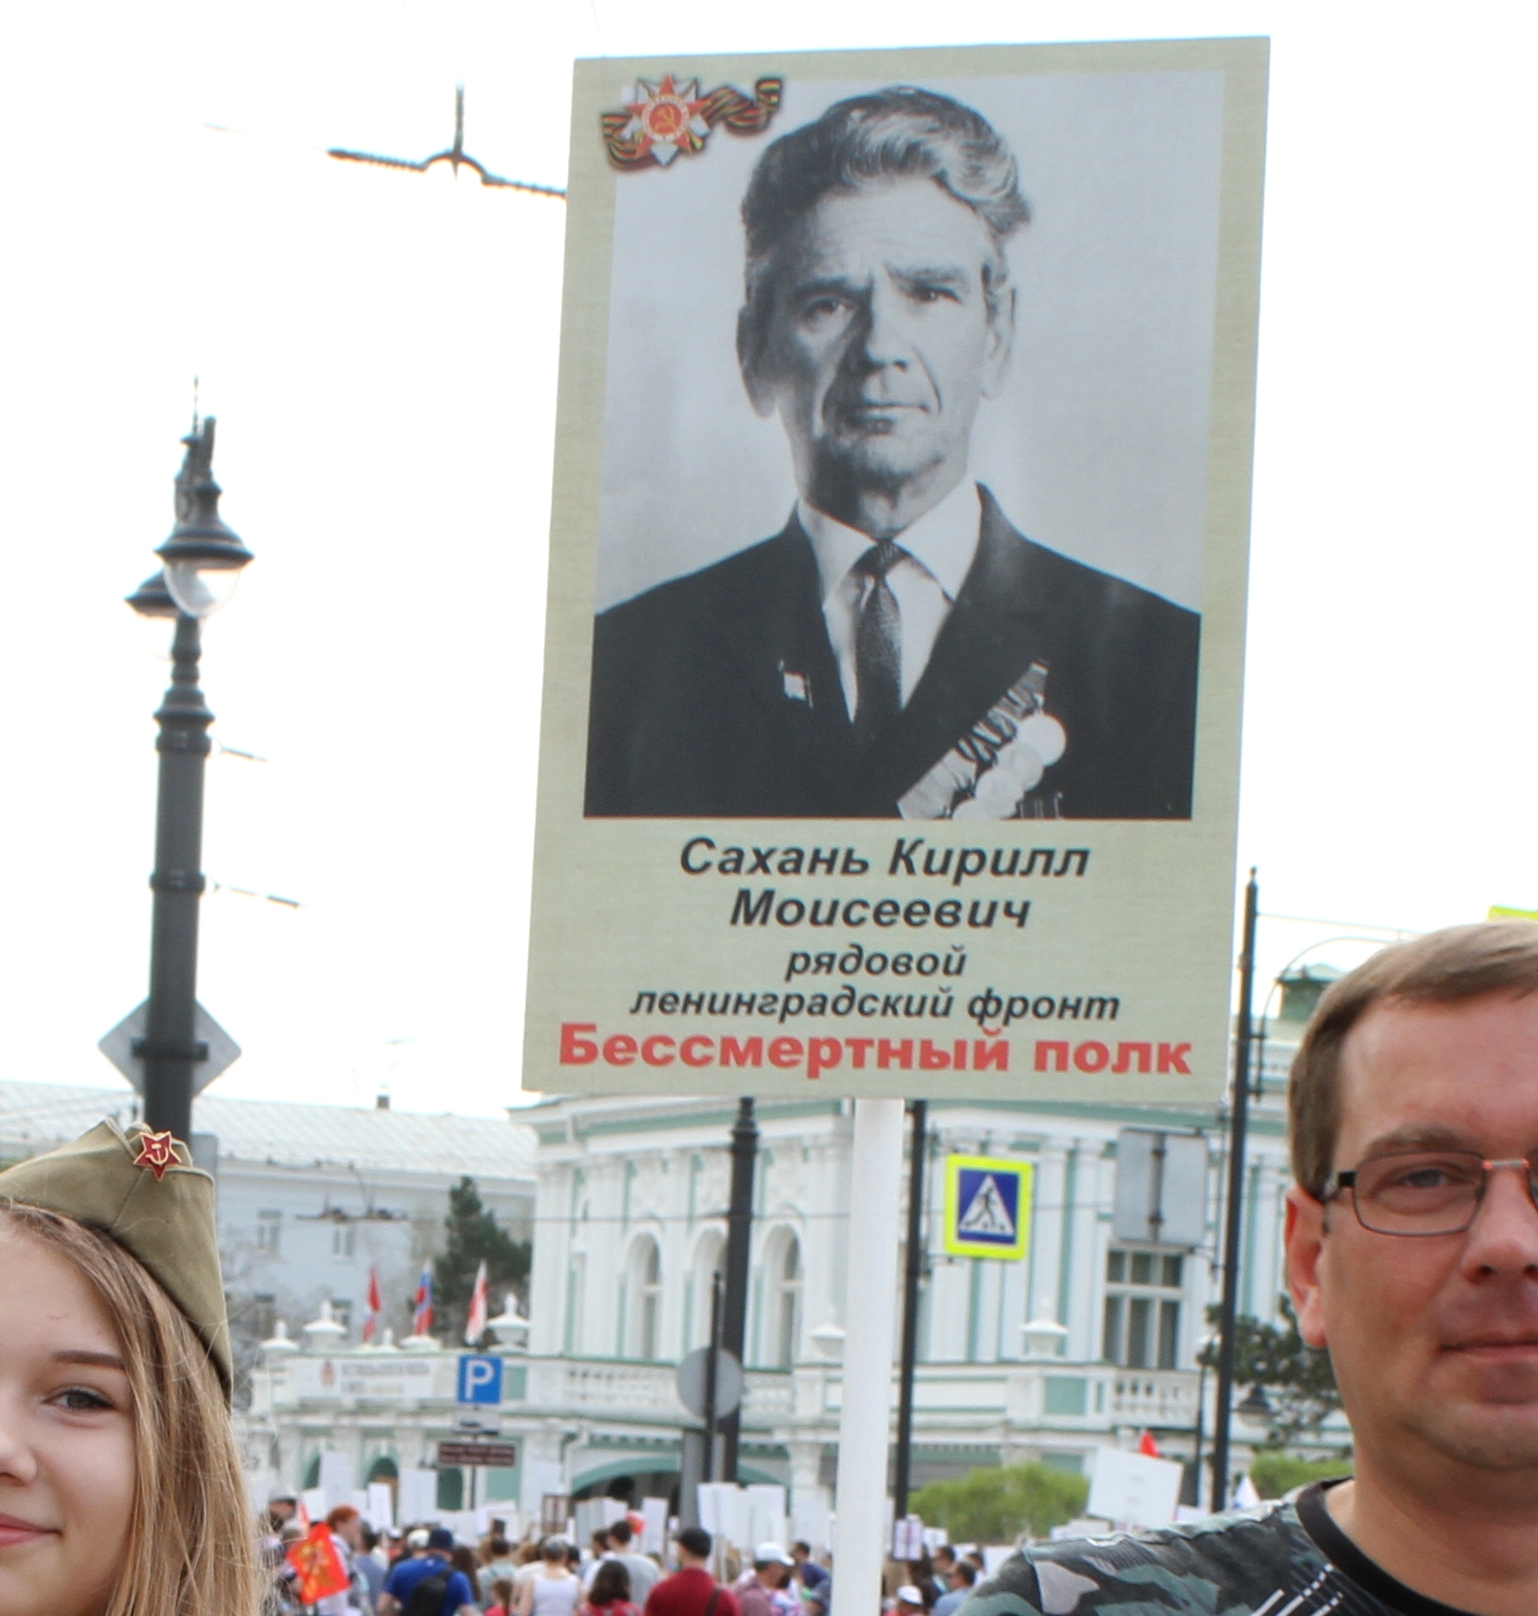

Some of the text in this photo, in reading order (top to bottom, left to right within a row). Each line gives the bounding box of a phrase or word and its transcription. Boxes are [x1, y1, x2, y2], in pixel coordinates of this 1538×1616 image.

[679, 836, 1091, 886] Сахань Кирилл
[729, 888, 1032, 929] Моисеевич
[784, 943, 968, 983] рядовой
[629, 985, 1121, 1028] ленинградский фронт
[559, 1022, 1193, 1080] Бессмертный полк
[465, 1360, 494, 1400] P
